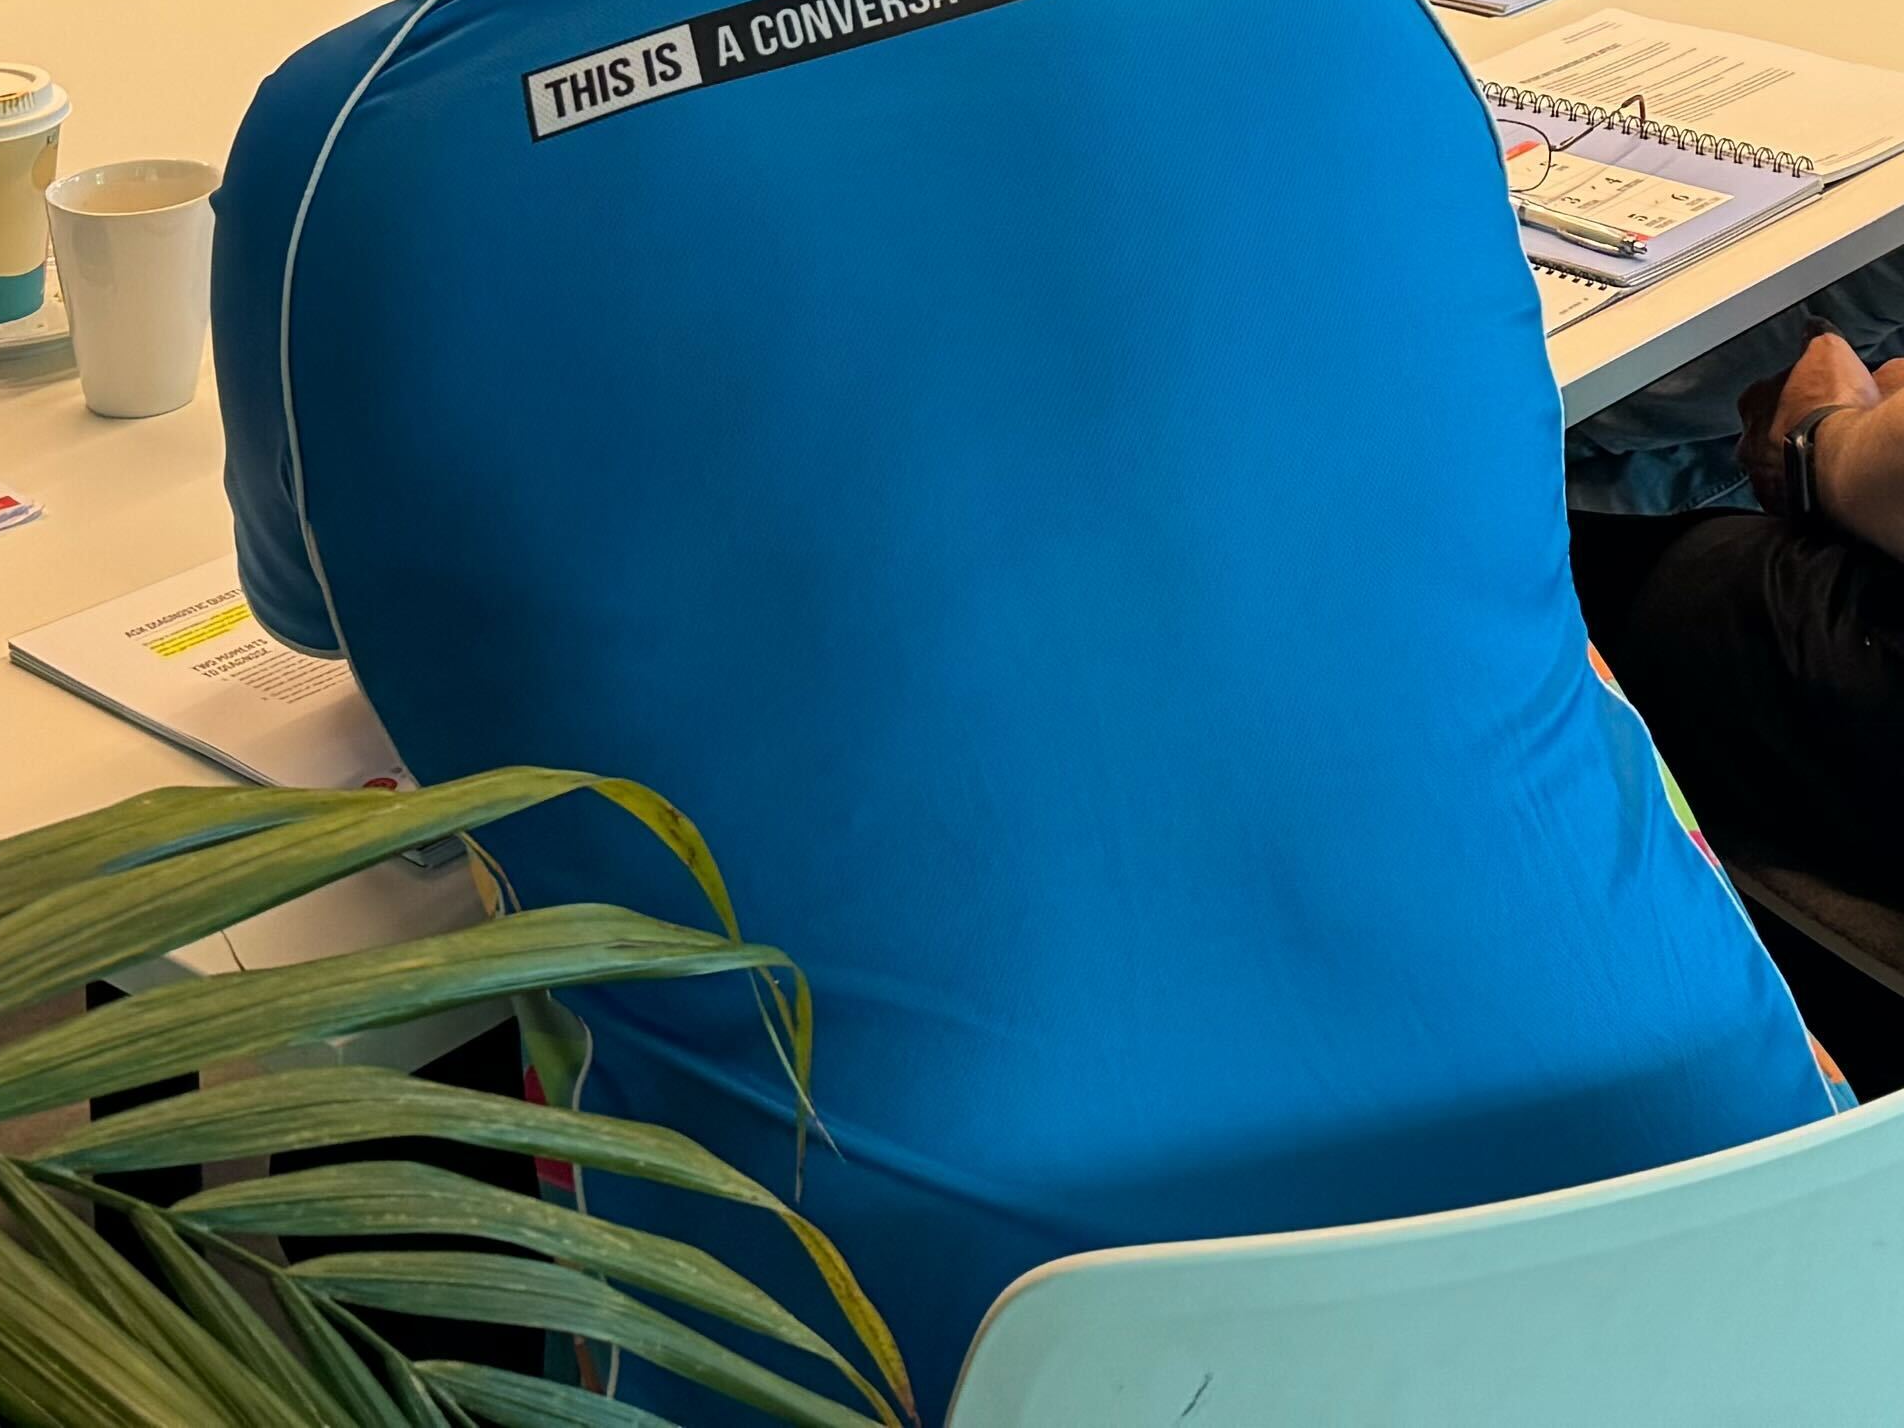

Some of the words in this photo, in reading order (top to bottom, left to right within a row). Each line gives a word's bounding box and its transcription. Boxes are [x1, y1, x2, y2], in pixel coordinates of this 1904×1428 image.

[543, 55, 636, 119] THIS
[640, 41, 684, 89] IS
[717, 25, 746, 67] A
